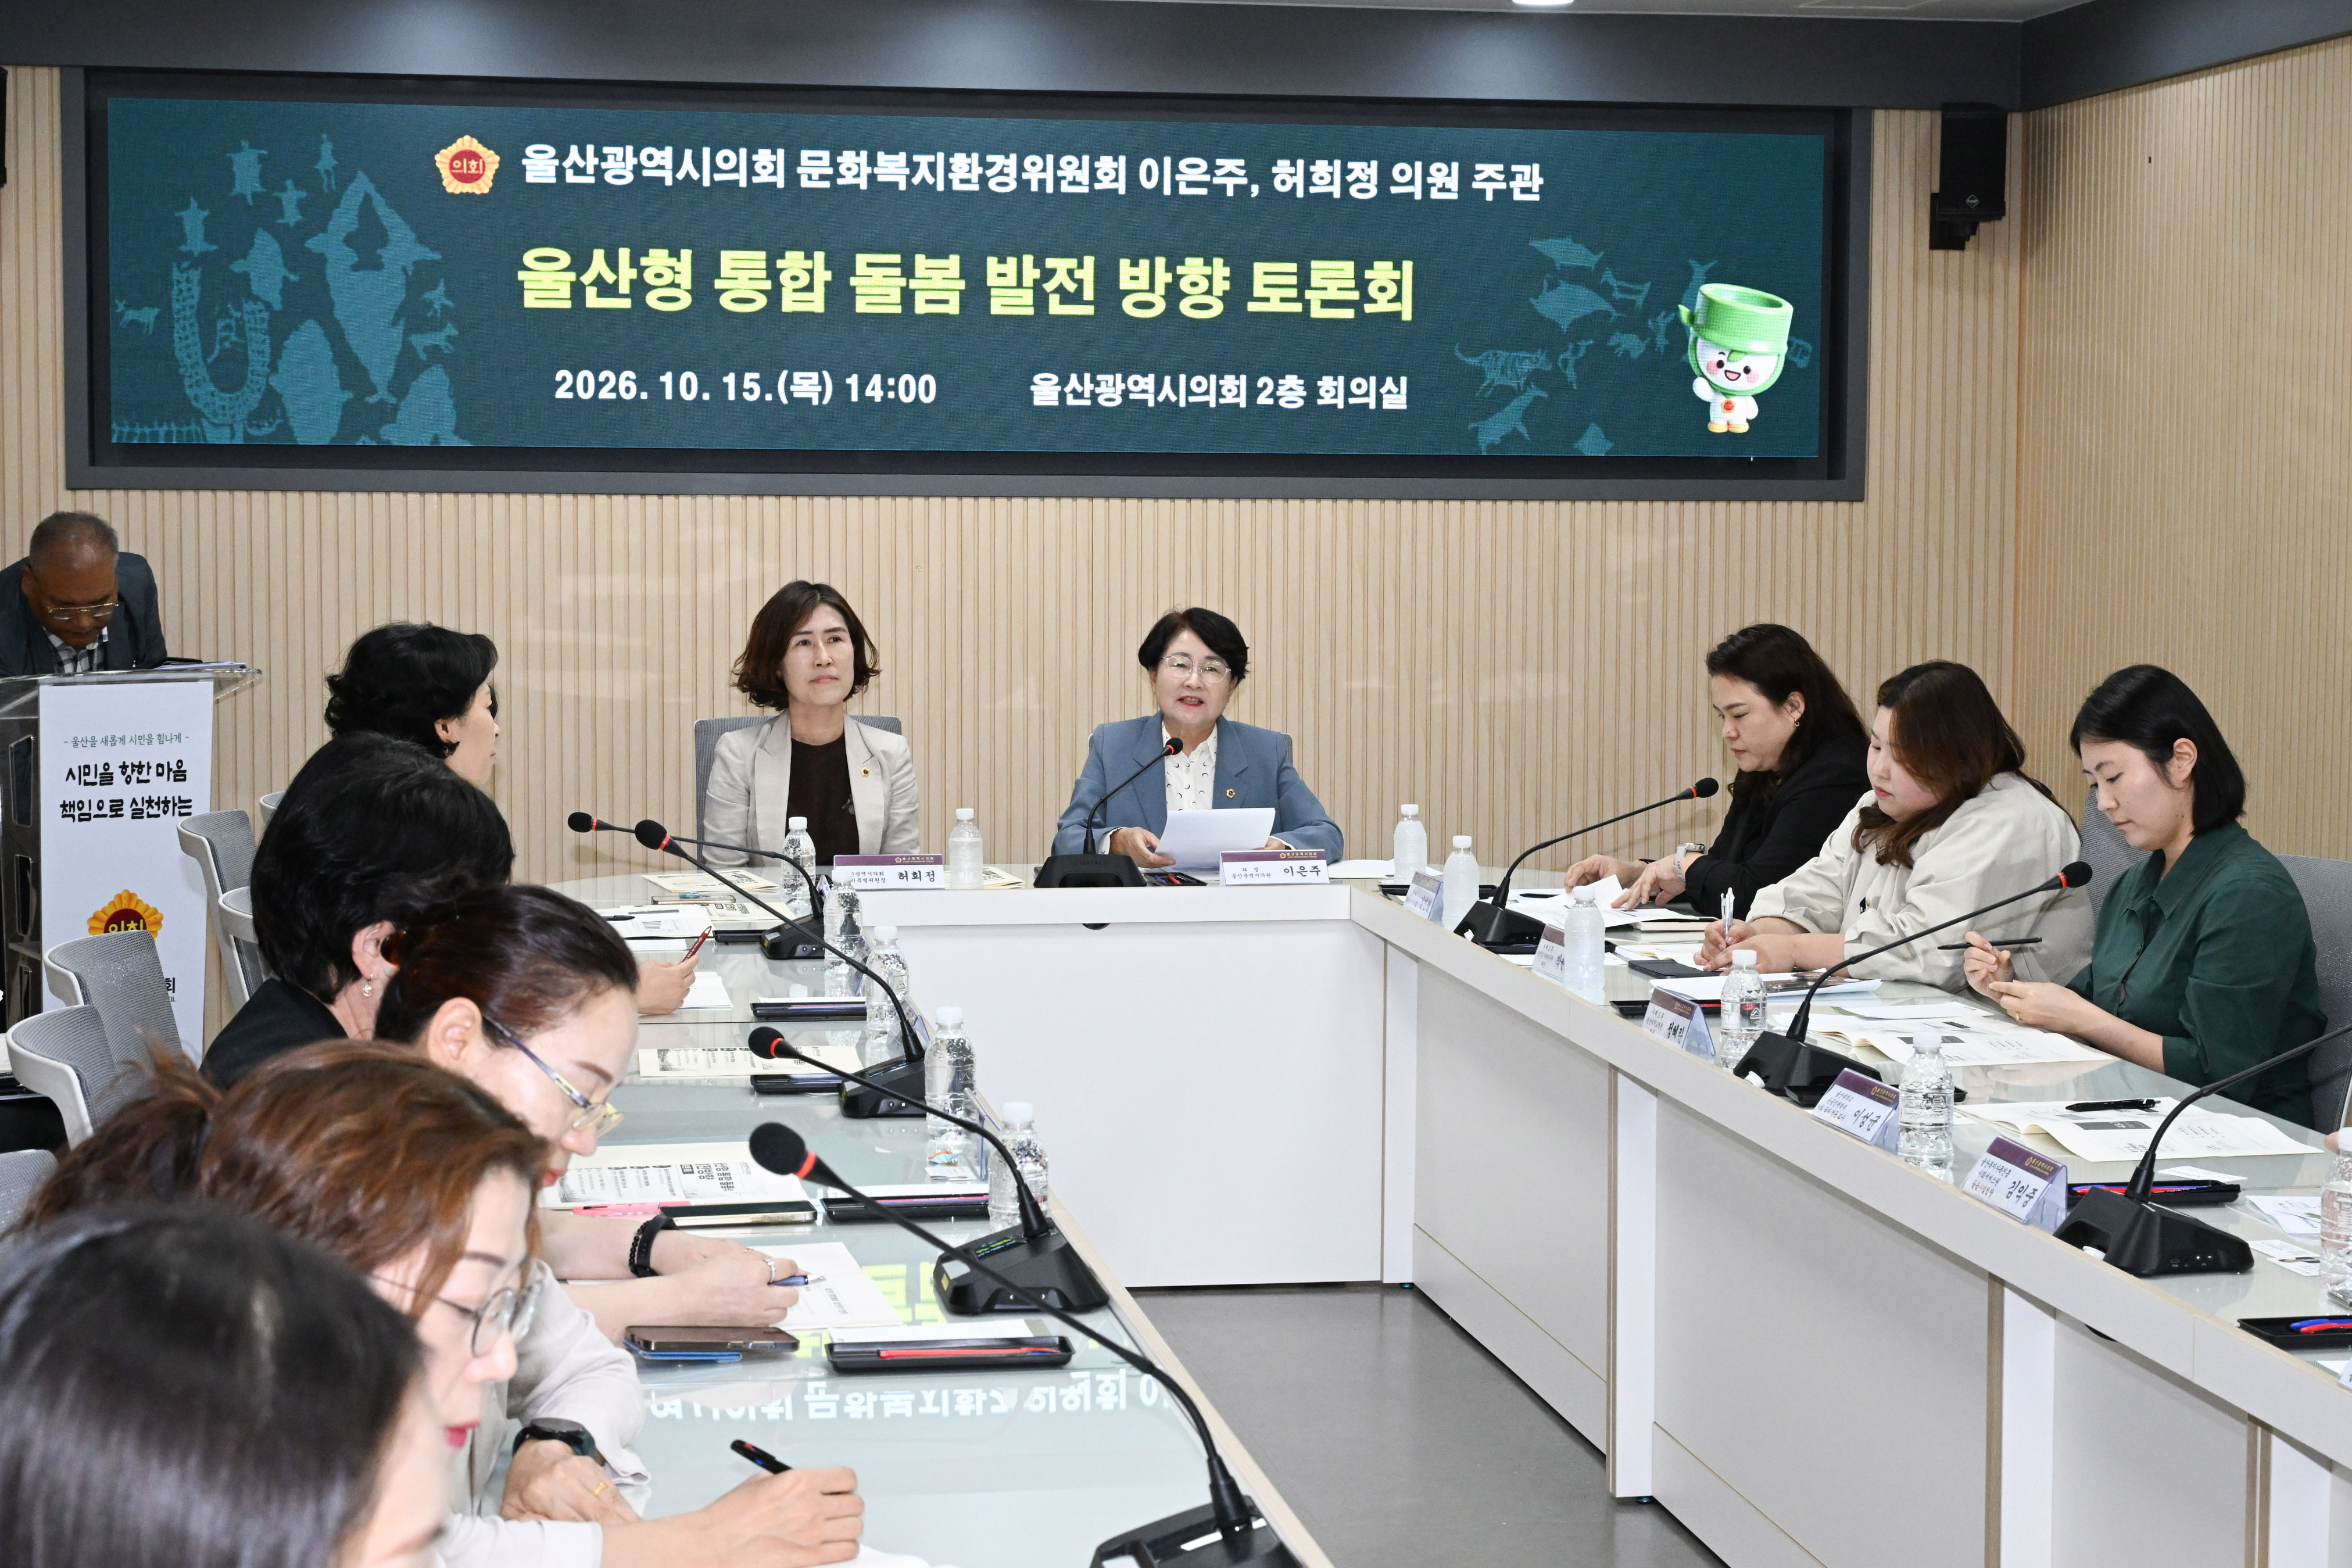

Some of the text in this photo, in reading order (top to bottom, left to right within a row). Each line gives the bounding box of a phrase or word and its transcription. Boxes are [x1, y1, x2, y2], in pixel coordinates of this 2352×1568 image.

[453, 157, 483, 174] 의회
[521, 144, 1544, 201] 울산광역시의회 문화복지환경위원회 이은주, 허희정 의원 주관
[517, 247, 1413, 321] 울산형 통합 돌봄 발전 방향 토론회
[555, 370, 936, 406] 2026. 10. 15.(목) 14:00
[1030, 373, 1407, 409] 울산광역시의회 2층 회의실
[71, 736, 98, 749] 울산을
[100, 735, 126, 747] 새롭게
[129, 733, 155, 746] 시민을
[157, 732, 182, 745] 힘나게
[66, 759, 187, 786] 시민을 향한 마음
[59, 795, 192, 822] 책임으로 실천하는
[1283, 865, 1321, 877] 이은주
[1853, 1108, 1881, 1131] 이성균
